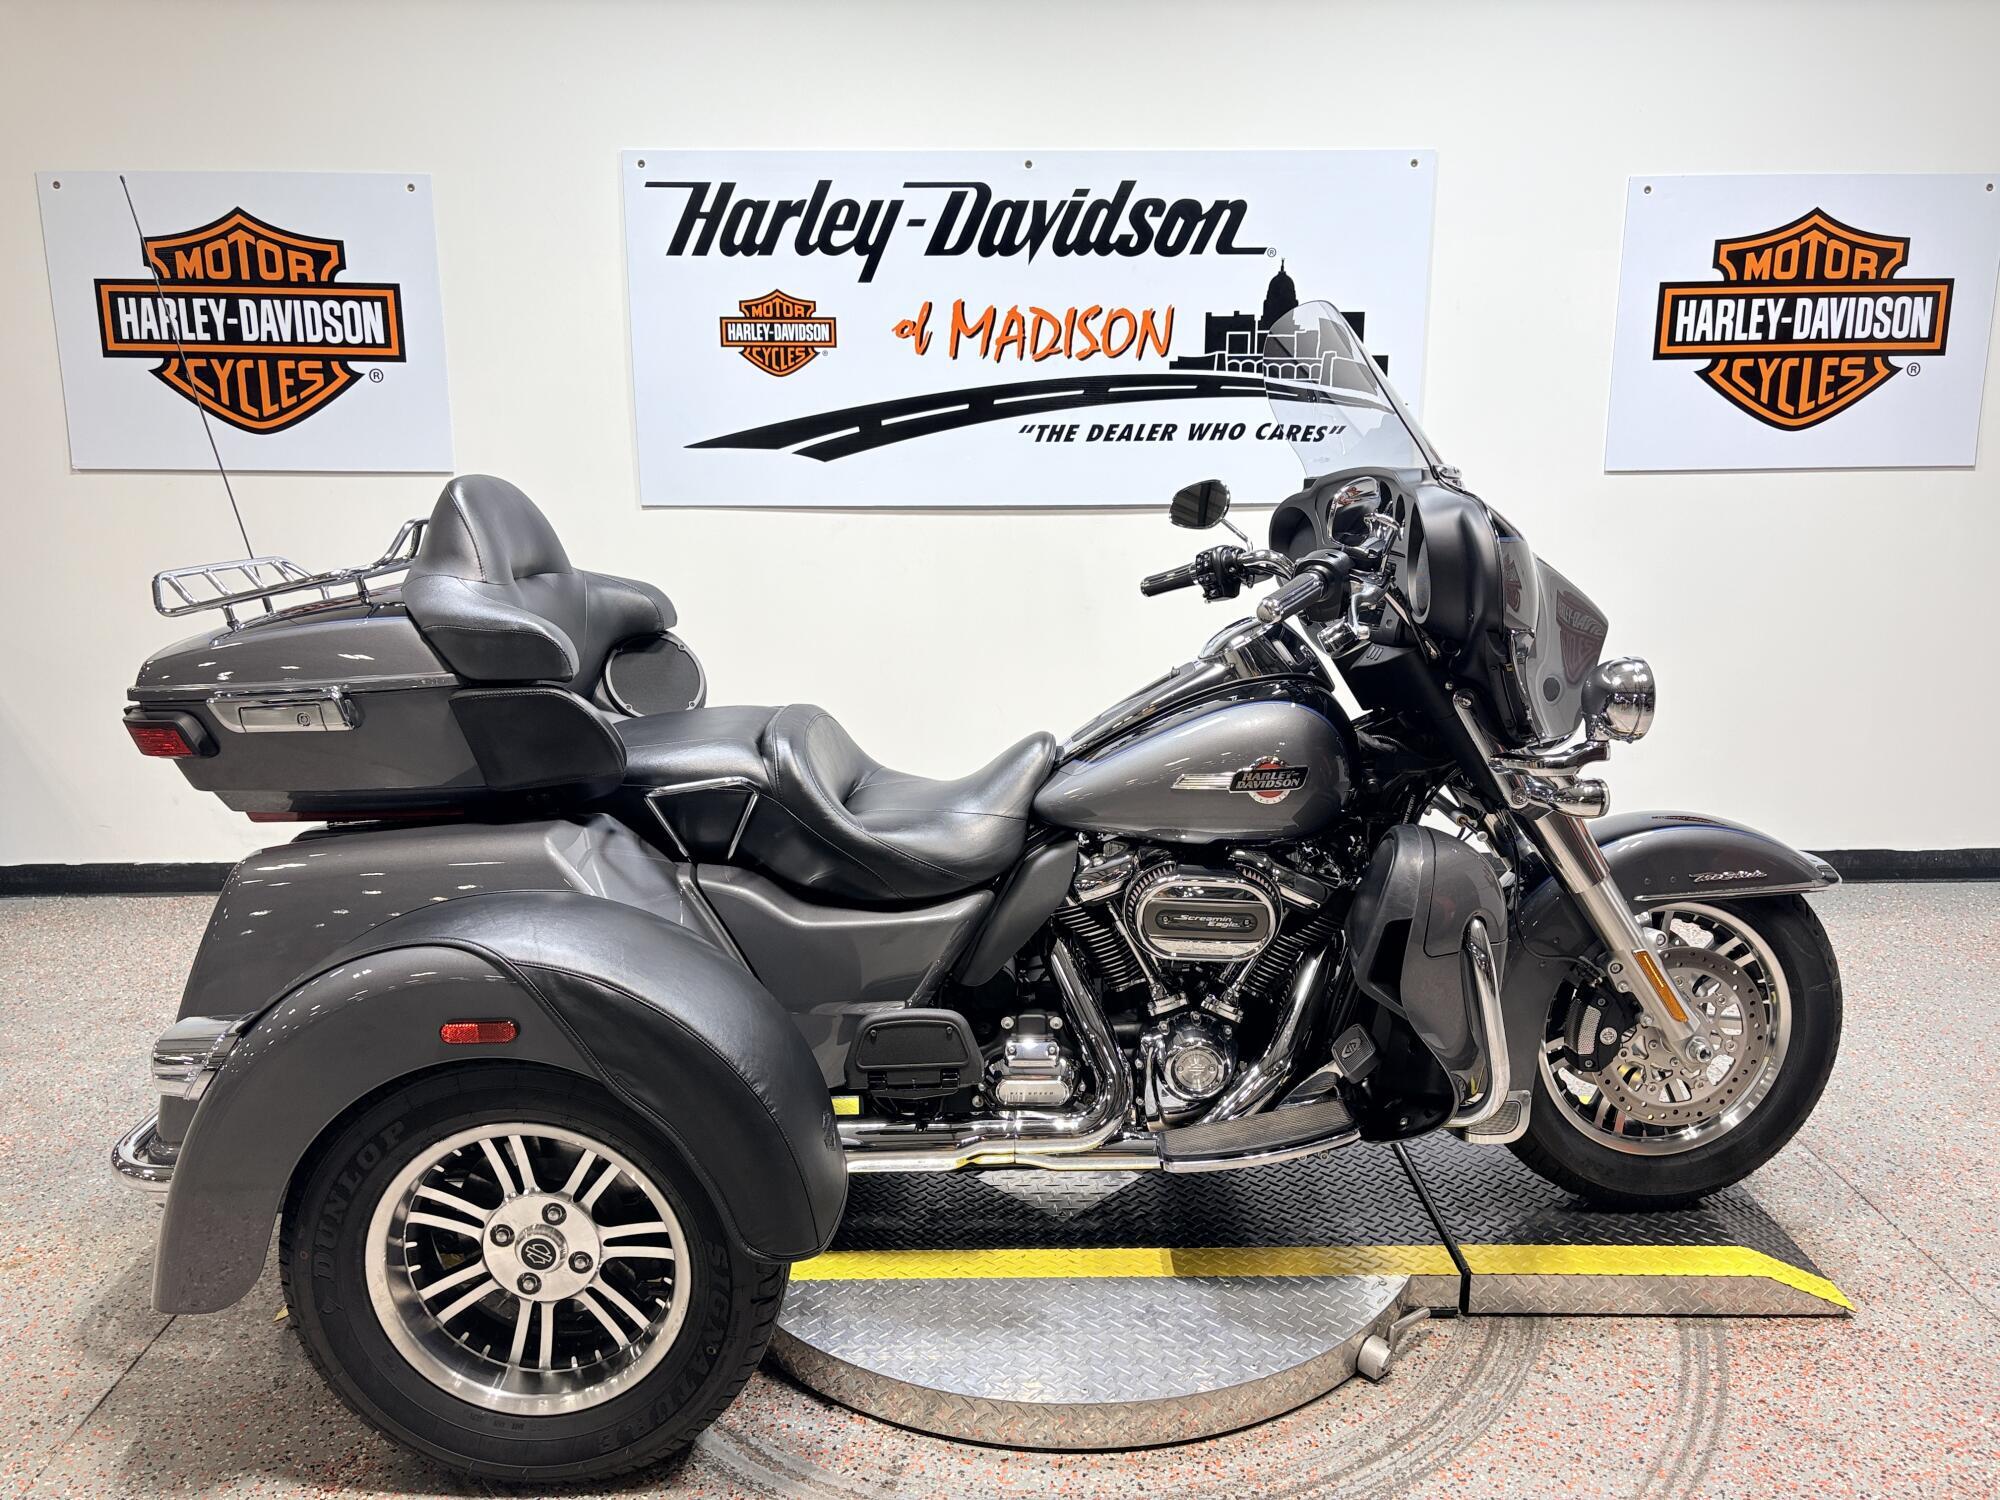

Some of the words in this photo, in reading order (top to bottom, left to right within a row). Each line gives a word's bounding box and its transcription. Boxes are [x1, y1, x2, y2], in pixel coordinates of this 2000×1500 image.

[174, 228, 316, 283] MOTOR
[644, 179, 1268, 283] Harley-Davidson
[1742, 229, 1879, 281] MOTOR
[116, 296, 386, 345] HARLEY-DAVIDSON
[727, 322, 830, 342] HARLEY-DAVIDSON
[751, 297, 805, 318] MOTOR
[948, 298, 1175, 363] MADISON
[1674, 296, 1934, 343] HARLEY-DAVIDSON
[751, 346, 806, 371] CYCLES
[184, 357, 325, 418] CYCLES
[1731, 356, 1865, 416] CYCLES
[1085, 423, 1178, 442] DEALER
[1187, 422, 1247, 441] WHO
[1235, 777, 1301, 789] DAVIDSON
[312, 1119, 406, 1283] DUNLOP
